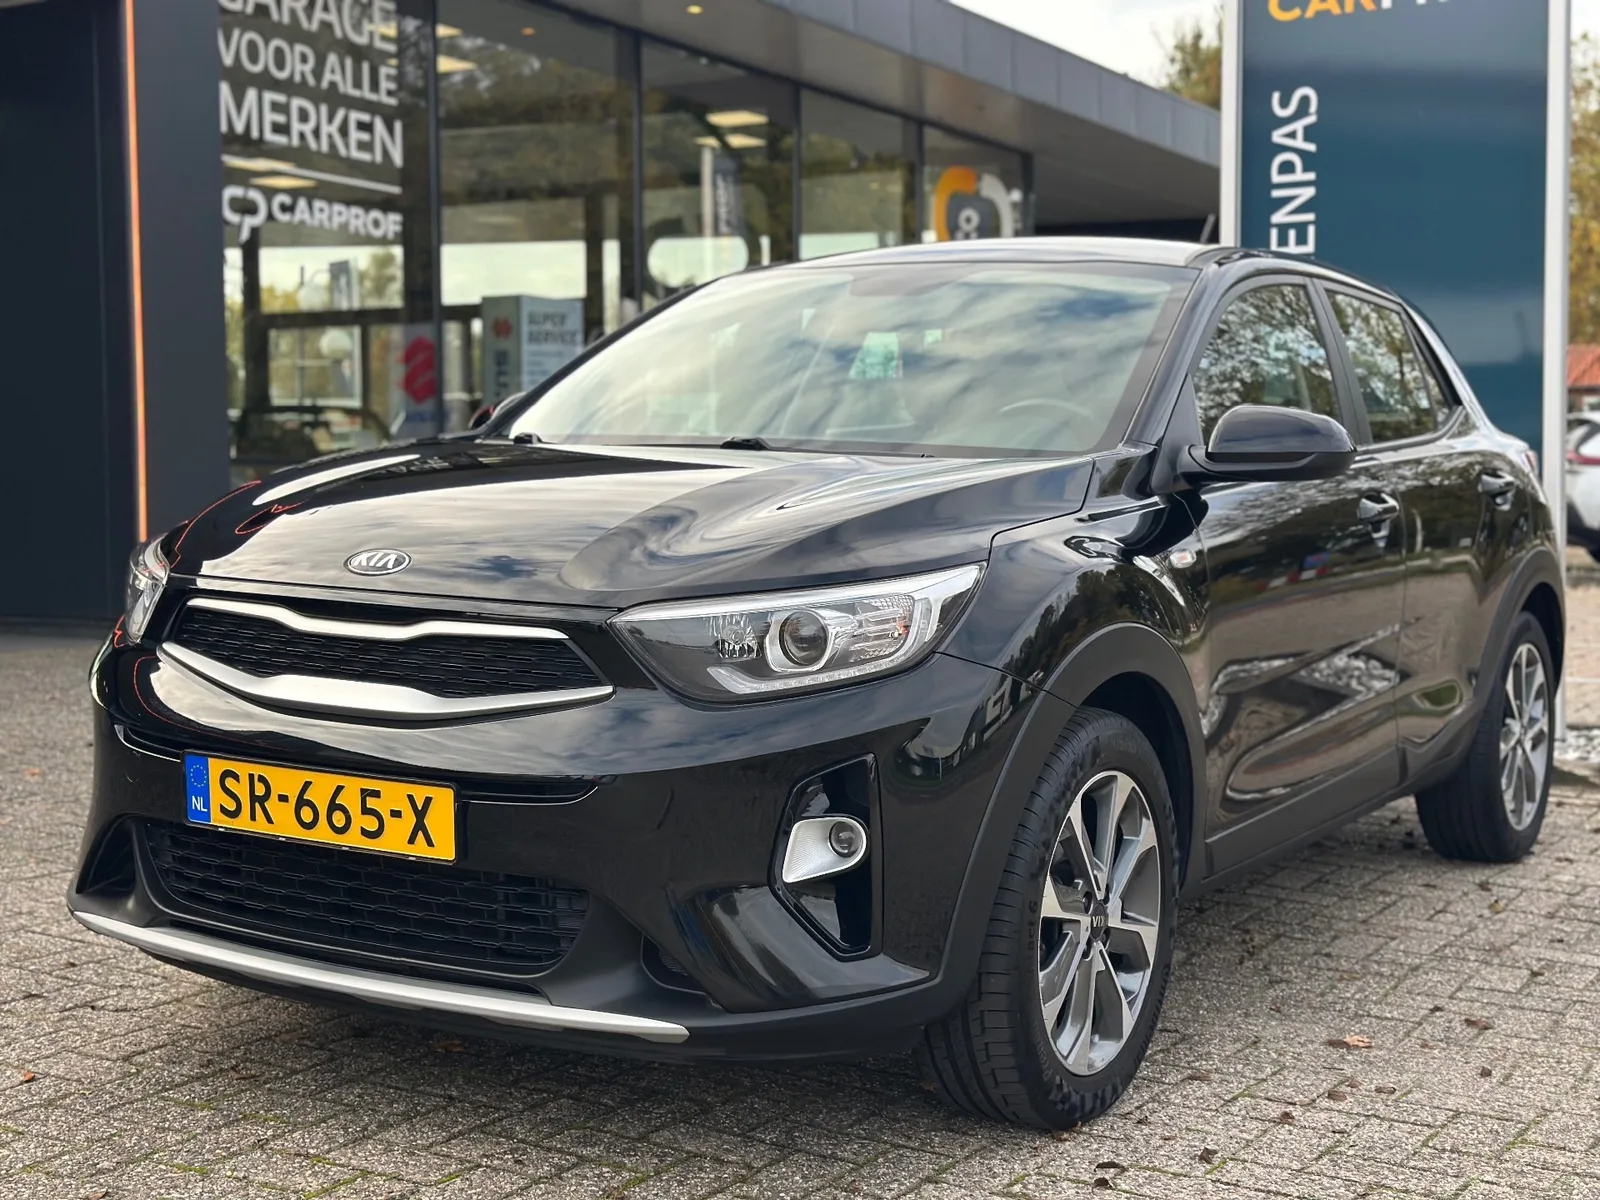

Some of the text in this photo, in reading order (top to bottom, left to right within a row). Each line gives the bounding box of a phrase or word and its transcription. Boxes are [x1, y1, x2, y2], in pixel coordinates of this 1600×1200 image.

[217, 0, 397, 53] RAGE
[217, 27, 398, 106] VOOR ALLE
[218, 81, 403, 168] MERKEN
[1270, 86, 1319, 254] ENPAS
[271, 193, 403, 239] CARPROF
[353, 551, 398, 569] KIA
[191, 795, 208, 812] NL
[218, 768, 435, 848] SR-665-X
